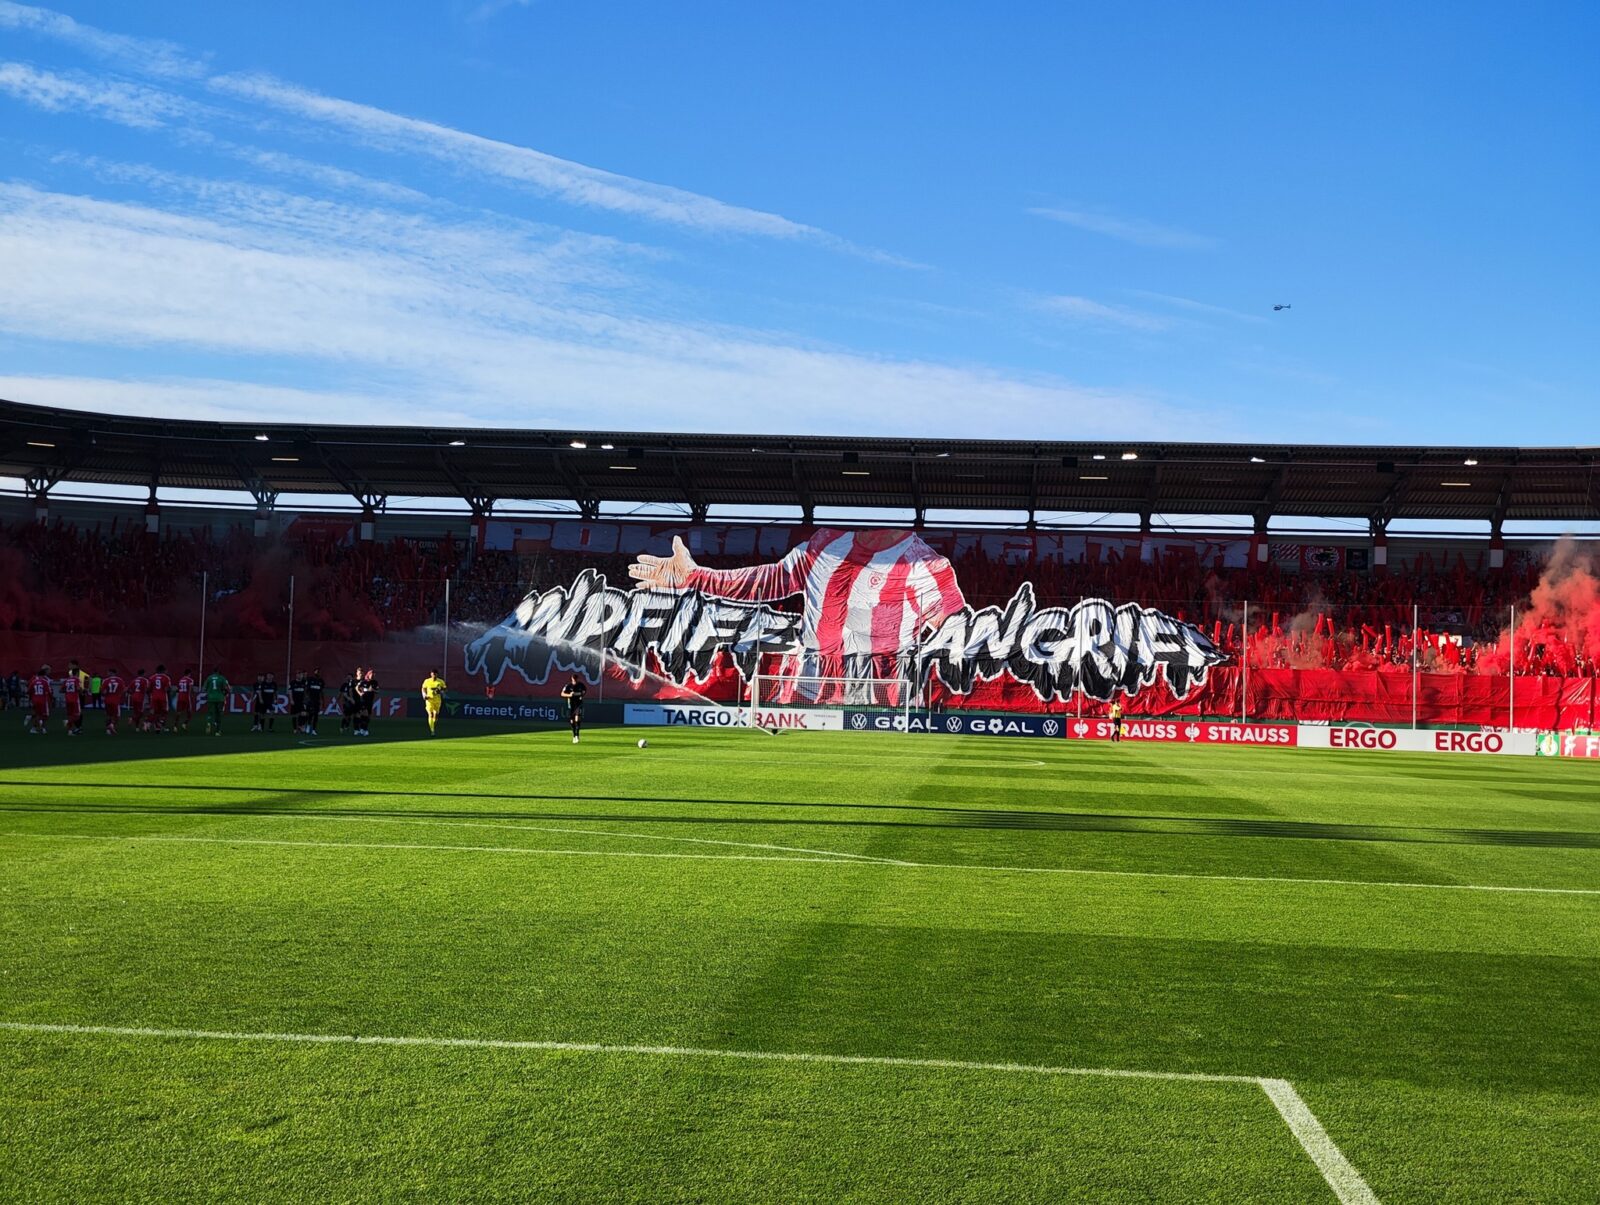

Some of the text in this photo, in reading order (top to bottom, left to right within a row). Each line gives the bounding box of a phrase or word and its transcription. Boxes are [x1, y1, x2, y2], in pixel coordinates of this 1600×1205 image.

[108, 682, 118, 693] 17
[212, 679, 217, 690] 1
[464, 703, 517, 719] freenet,
[519, 705, 559, 720] fertig,
[663, 708, 731, 726] TARGO
[874, 715, 939, 731] GOAL
[969, 717, 1034, 735] GOAL
[1096, 722, 1290, 743] STRAUSS STRAUSS
[1329, 728, 1503, 753] ERGO ERGO
